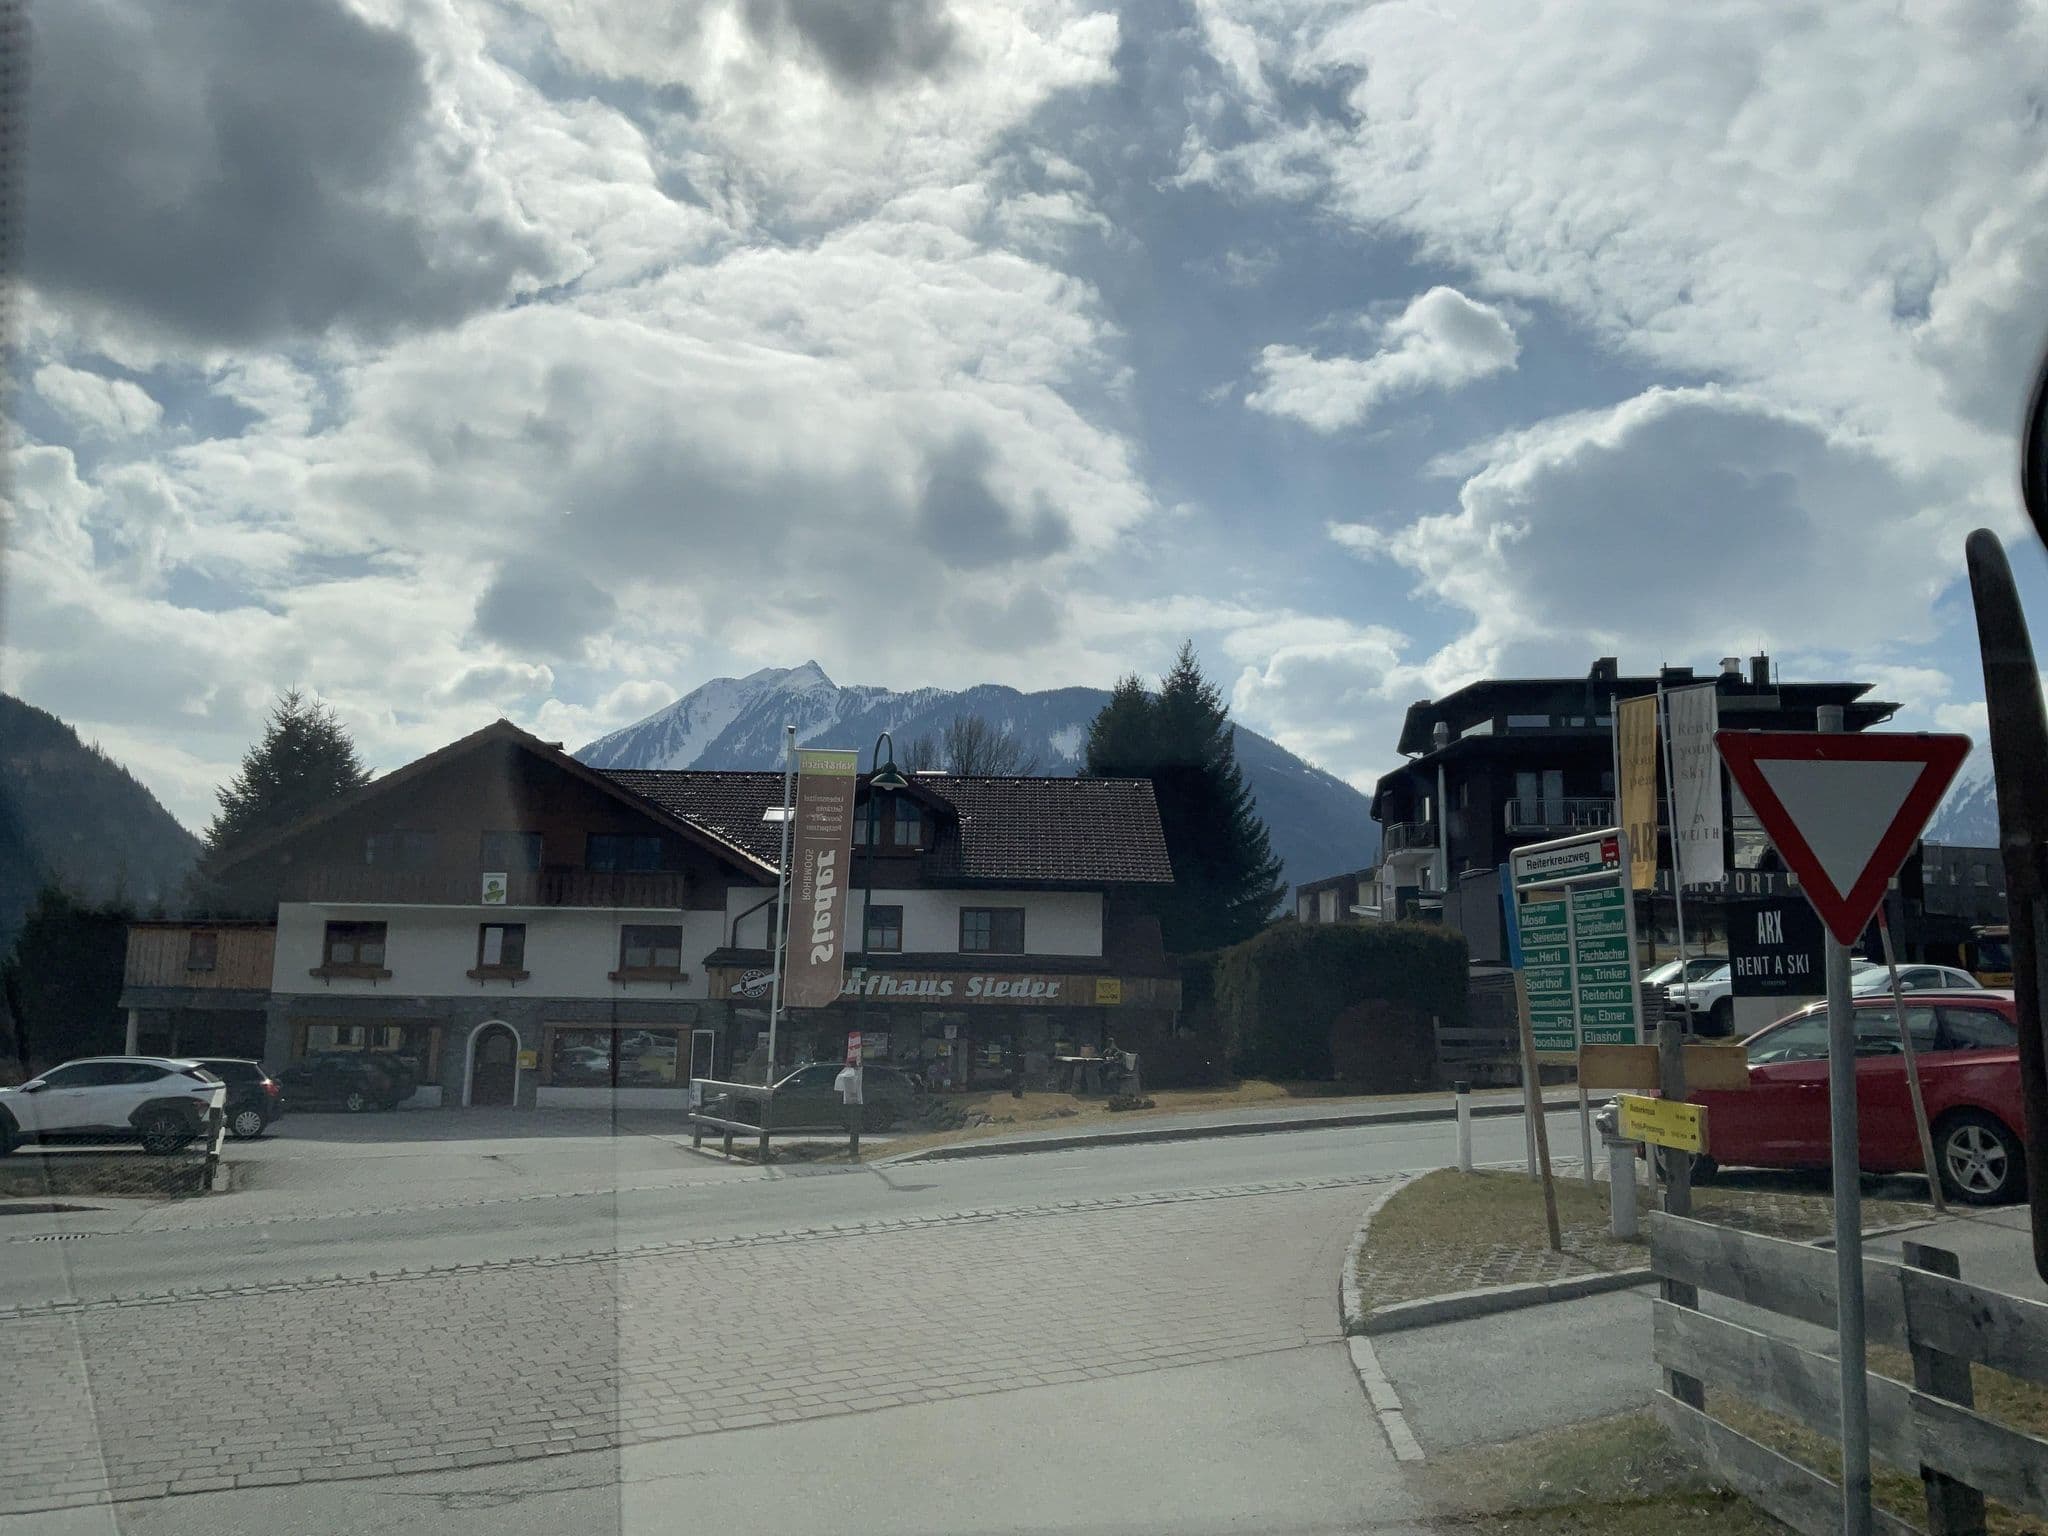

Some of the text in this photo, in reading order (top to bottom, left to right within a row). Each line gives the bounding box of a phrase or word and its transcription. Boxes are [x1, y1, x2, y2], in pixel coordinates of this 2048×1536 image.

[1526, 850, 1590, 870] Reiterkreuzweg
[1522, 914, 1548, 925] Moser
[1757, 910, 1784, 945] ARX
[1579, 949, 1626, 961] Fischbacher
[1737, 954, 1810, 976] RENT A SKI
[1595, 967, 1627, 980] Trinker
[965, 976, 1061, 998] Sieder
[1526, 978, 1562, 991] Sporthof
[1581, 988, 1624, 1000] Reiterhof
[1557, 1016, 1573, 1028] Pilz
[1599, 1010, 1626, 1021] Ebner
